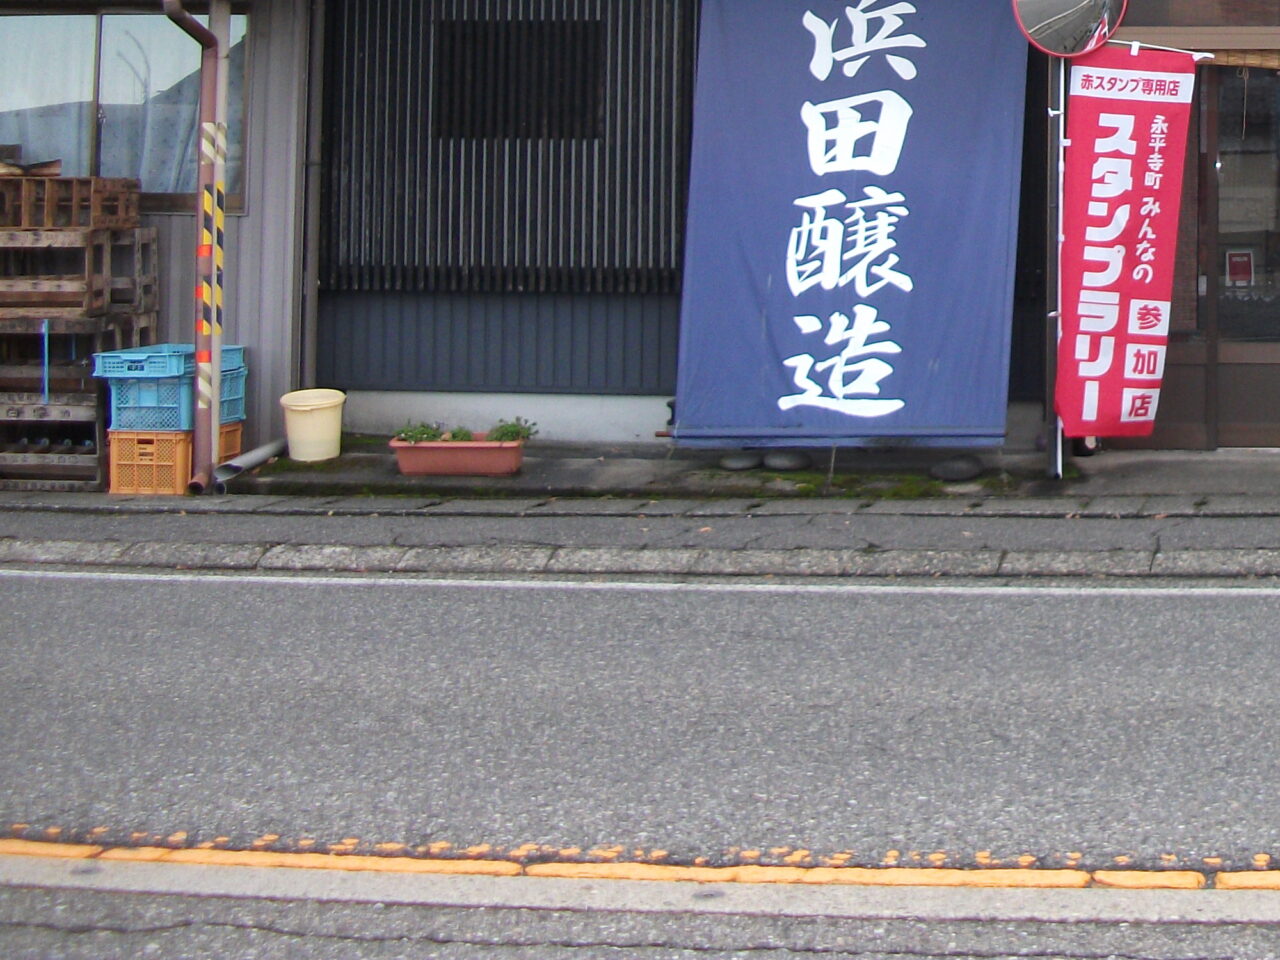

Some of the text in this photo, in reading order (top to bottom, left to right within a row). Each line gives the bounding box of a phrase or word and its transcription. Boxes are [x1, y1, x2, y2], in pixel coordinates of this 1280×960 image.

[1080, 74, 1180, 96] 赤スタンプ専用店
[1074, 113, 1137, 421] スタンプラリー
[1127, 114, 1168, 417] 永平寺町 みんなの 参加店
